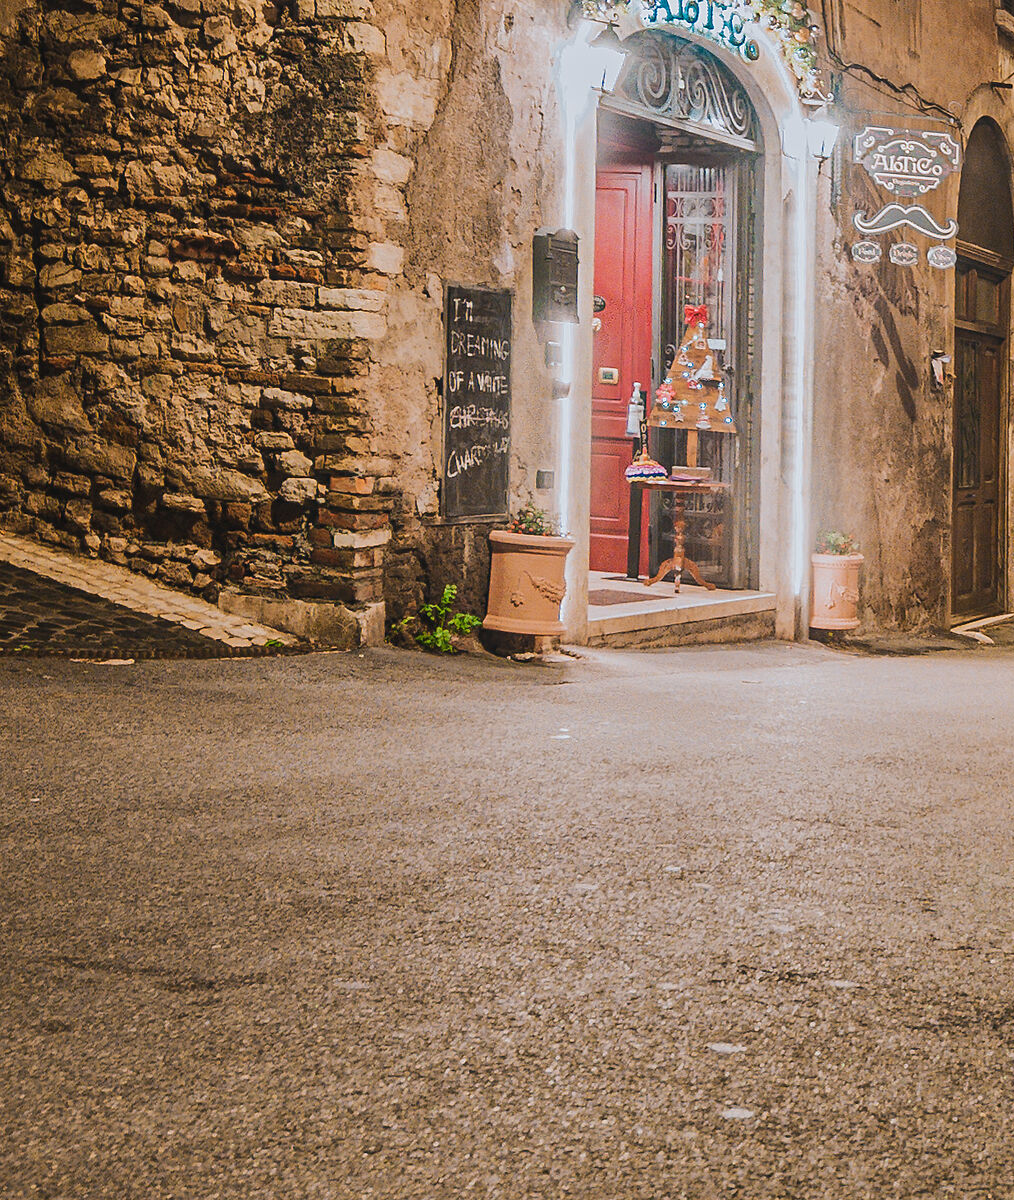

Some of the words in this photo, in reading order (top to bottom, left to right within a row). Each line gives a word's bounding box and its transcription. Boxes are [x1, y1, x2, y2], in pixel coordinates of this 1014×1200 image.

[451, 330, 510, 361] DREAMING
[449, 370, 465, 393] OF
[468, 371, 476, 393] A
[476, 371, 509, 396] WHITE
